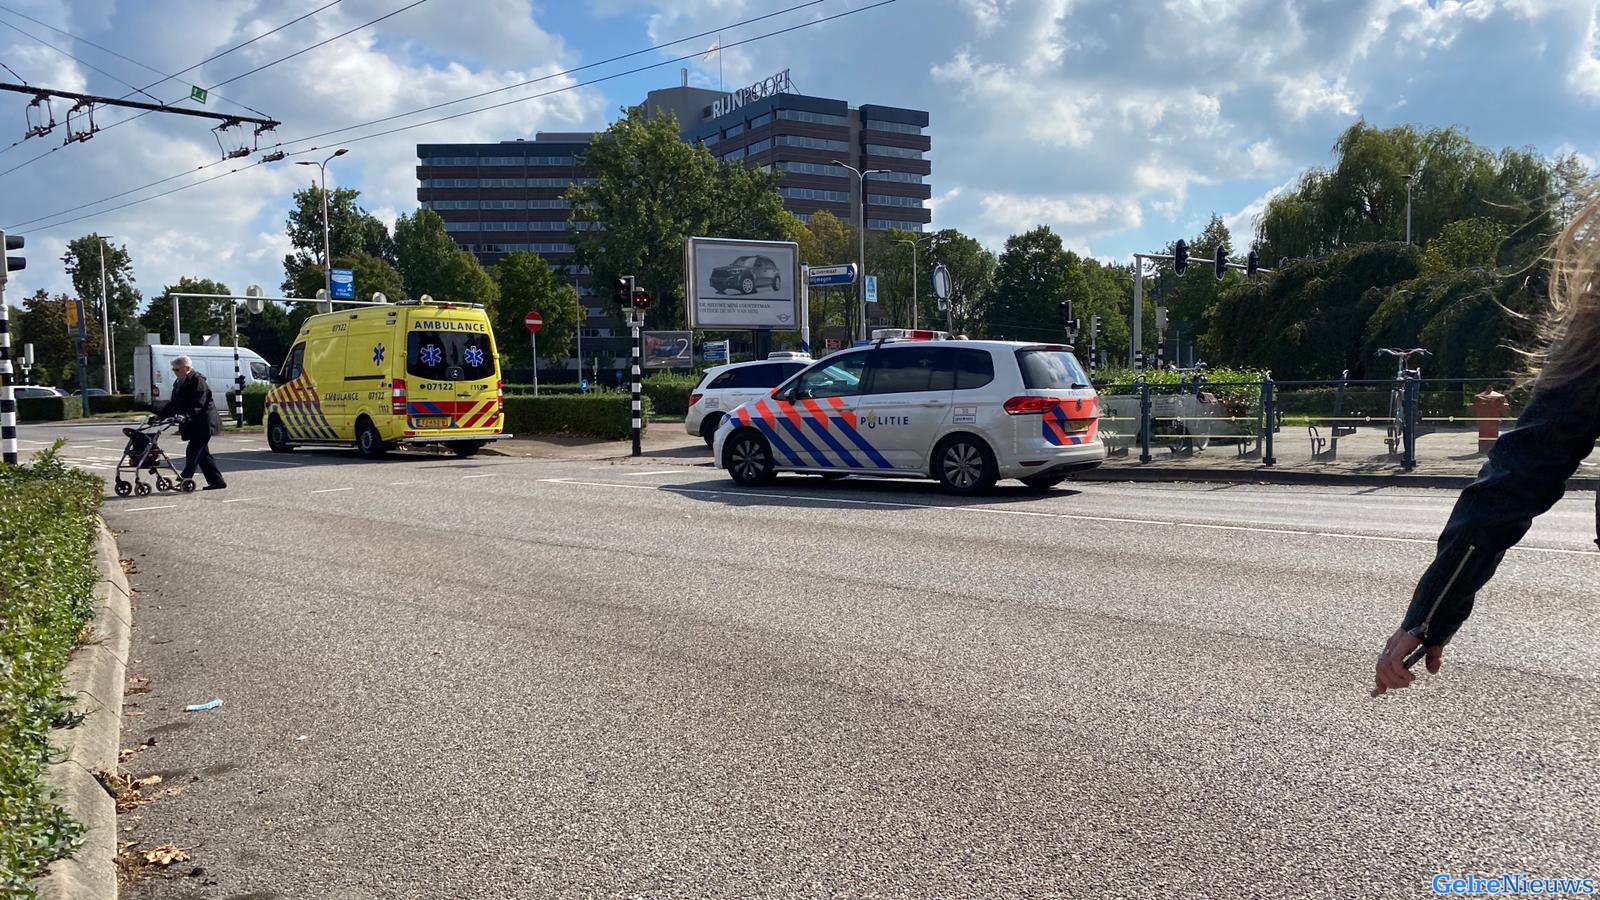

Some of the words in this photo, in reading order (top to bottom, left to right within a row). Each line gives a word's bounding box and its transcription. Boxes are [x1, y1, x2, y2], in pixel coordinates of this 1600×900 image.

[712, 69, 790, 119] RIJNPOORT
[414, 320, 485, 332] AMBULANCE
[676, 338, 690, 359] 2
[426, 383, 454, 391] 07122
[324, 392, 359, 401] AMBULANCE
[368, 391, 385, 400] 07122
[860, 416, 909, 429] POLITIE
